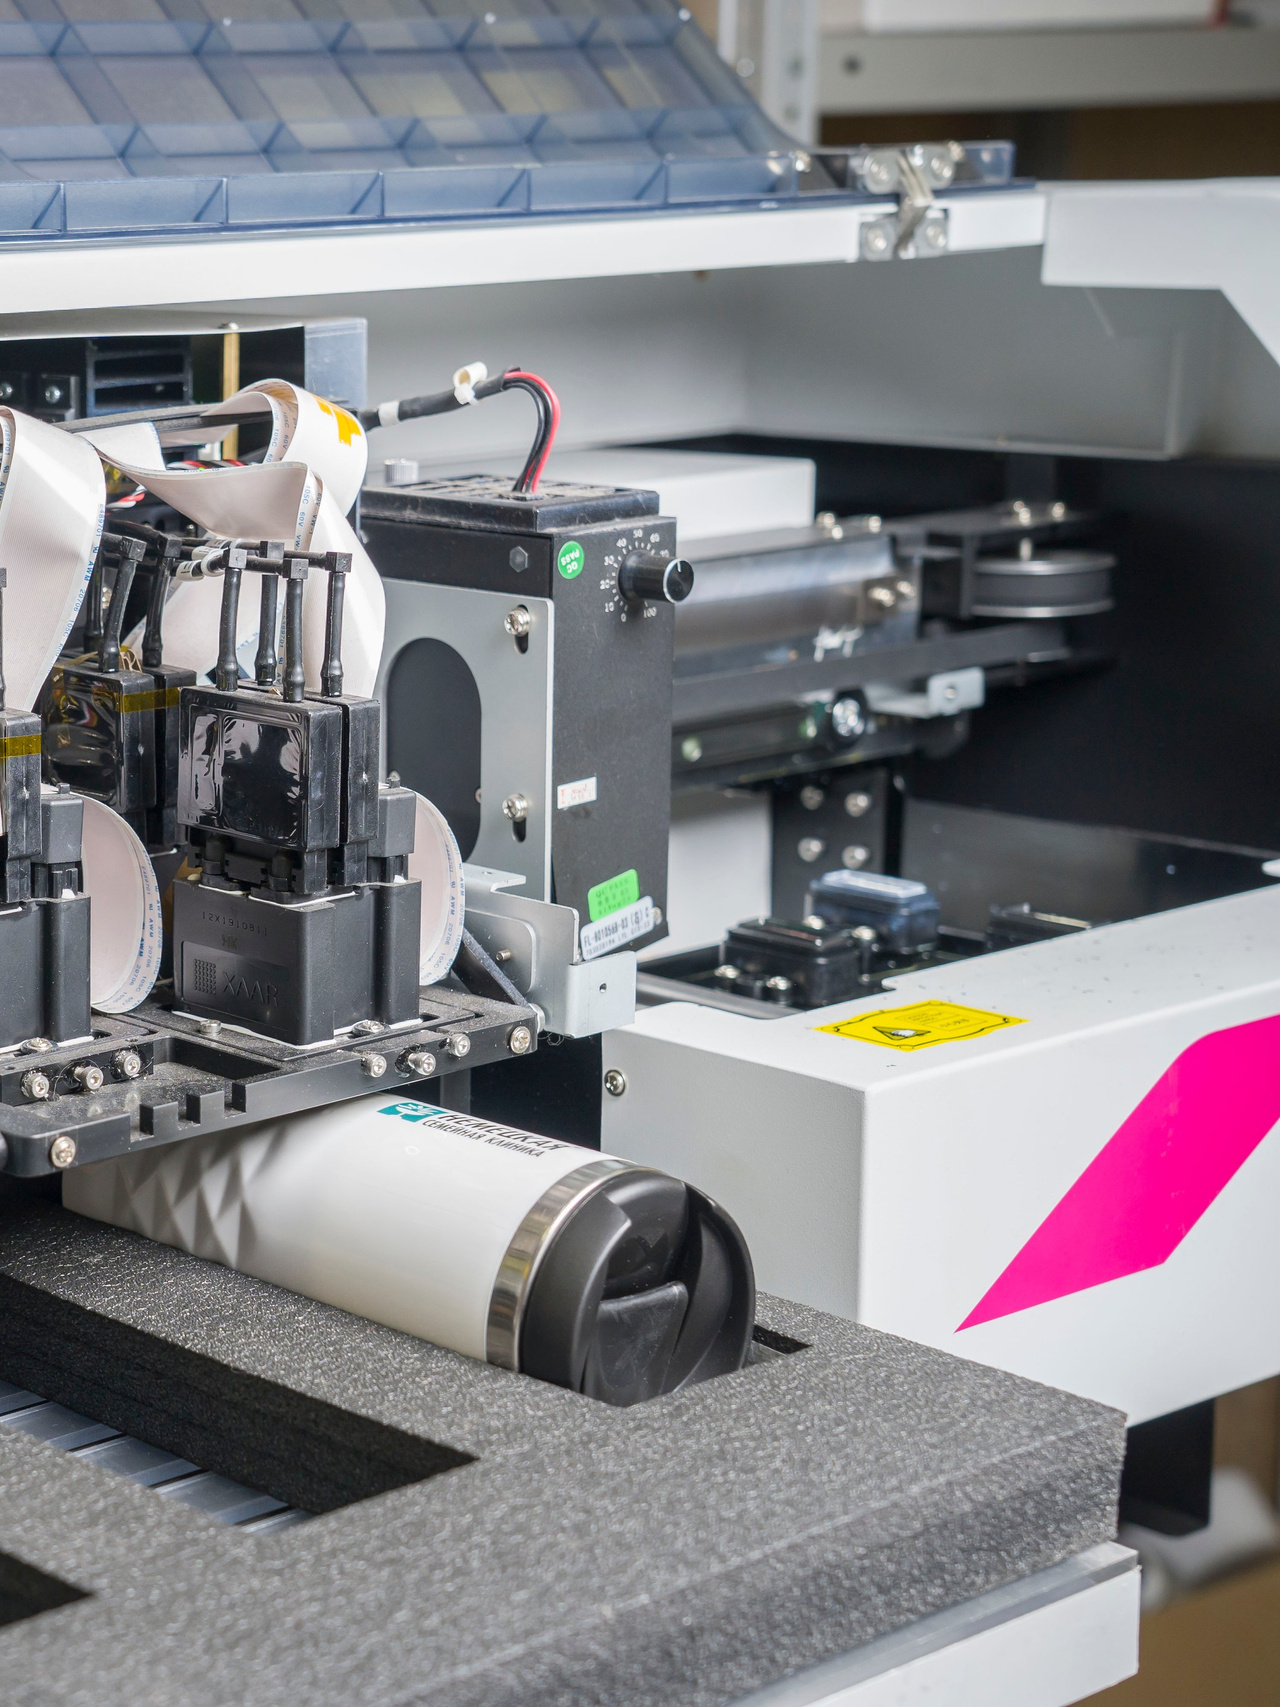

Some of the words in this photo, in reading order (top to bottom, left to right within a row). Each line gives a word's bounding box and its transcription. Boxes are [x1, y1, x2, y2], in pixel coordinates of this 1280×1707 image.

[302, 485, 311, 505] 105C
[298, 511, 306, 527] 60V
[616, 537, 627, 548] 40
[632, 528, 643, 539] 50
[649, 532, 661, 544] 60
[560, 548, 580, 566] PASS
[603, 554, 615, 566] 30
[83, 560, 94, 582] AWM
[566, 561, 579, 574] QC
[599, 578, 610, 590] 20
[73, 588, 86, 613] 20706
[604, 601, 615, 613] 10
[620, 612, 627, 623] 0
[643, 606, 657, 619] 100
[202, 910, 268, 937] 12X1910811
[444, 922, 454, 946] 20706
[146, 945, 154, 968] 20706
[433, 952, 446, 969] 105C
[129, 964, 141, 986] 20706
[136, 975, 147, 993] 105C
[223, 971, 279, 1008] XAAR
[422, 1118, 485, 1141] СЕМЕЙНАЯ
[484, 1136, 546, 1158] КЛИНИКА
[437, 1113, 570, 1151] НЕМЕЦКАЯ
